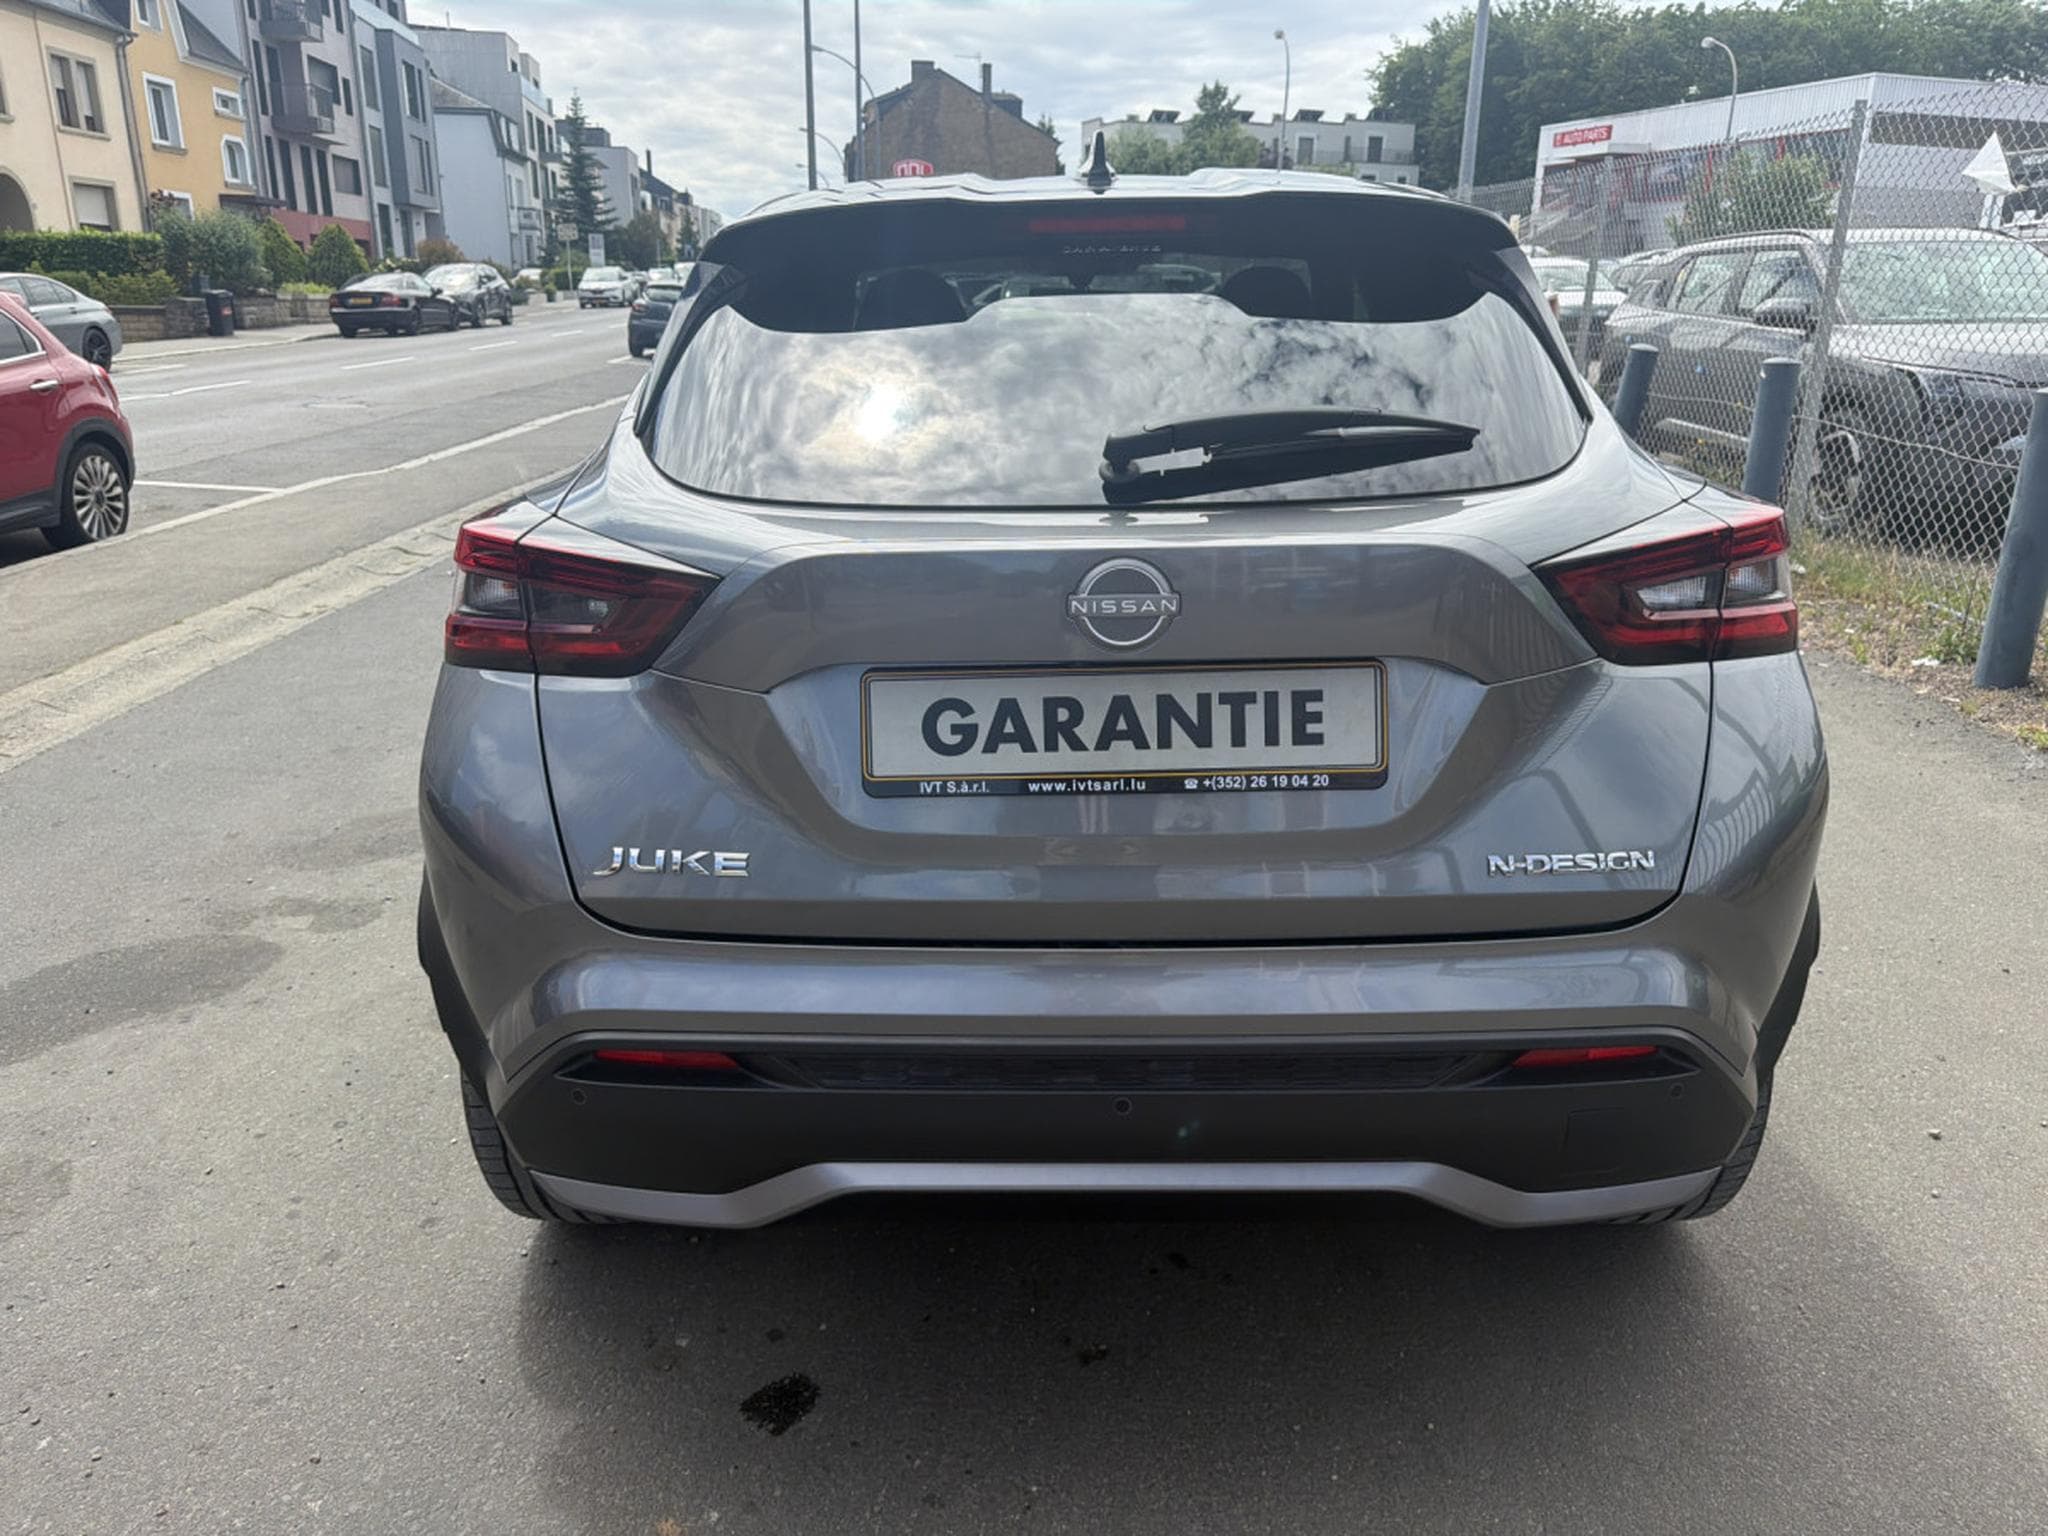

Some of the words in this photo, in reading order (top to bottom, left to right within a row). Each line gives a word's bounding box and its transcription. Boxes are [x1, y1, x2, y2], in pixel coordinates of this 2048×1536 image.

[1070, 599, 1177, 613] NISSAN
[921, 689, 1325, 757] GARANTIE
[919, 781, 943, 793] IVT
[1028, 778, 1147, 792] www.ivtsarl.lu
[1203, 775, 1247, 790] +(352)
[1250, 775, 1267, 788] 26
[1271, 775, 1287, 787] 19
[1292, 774, 1308, 787] 04
[1312, 774, 1329, 786] 20
[592, 847, 750, 877] JUKE
[1487, 850, 1655, 876] N-DESIGN
